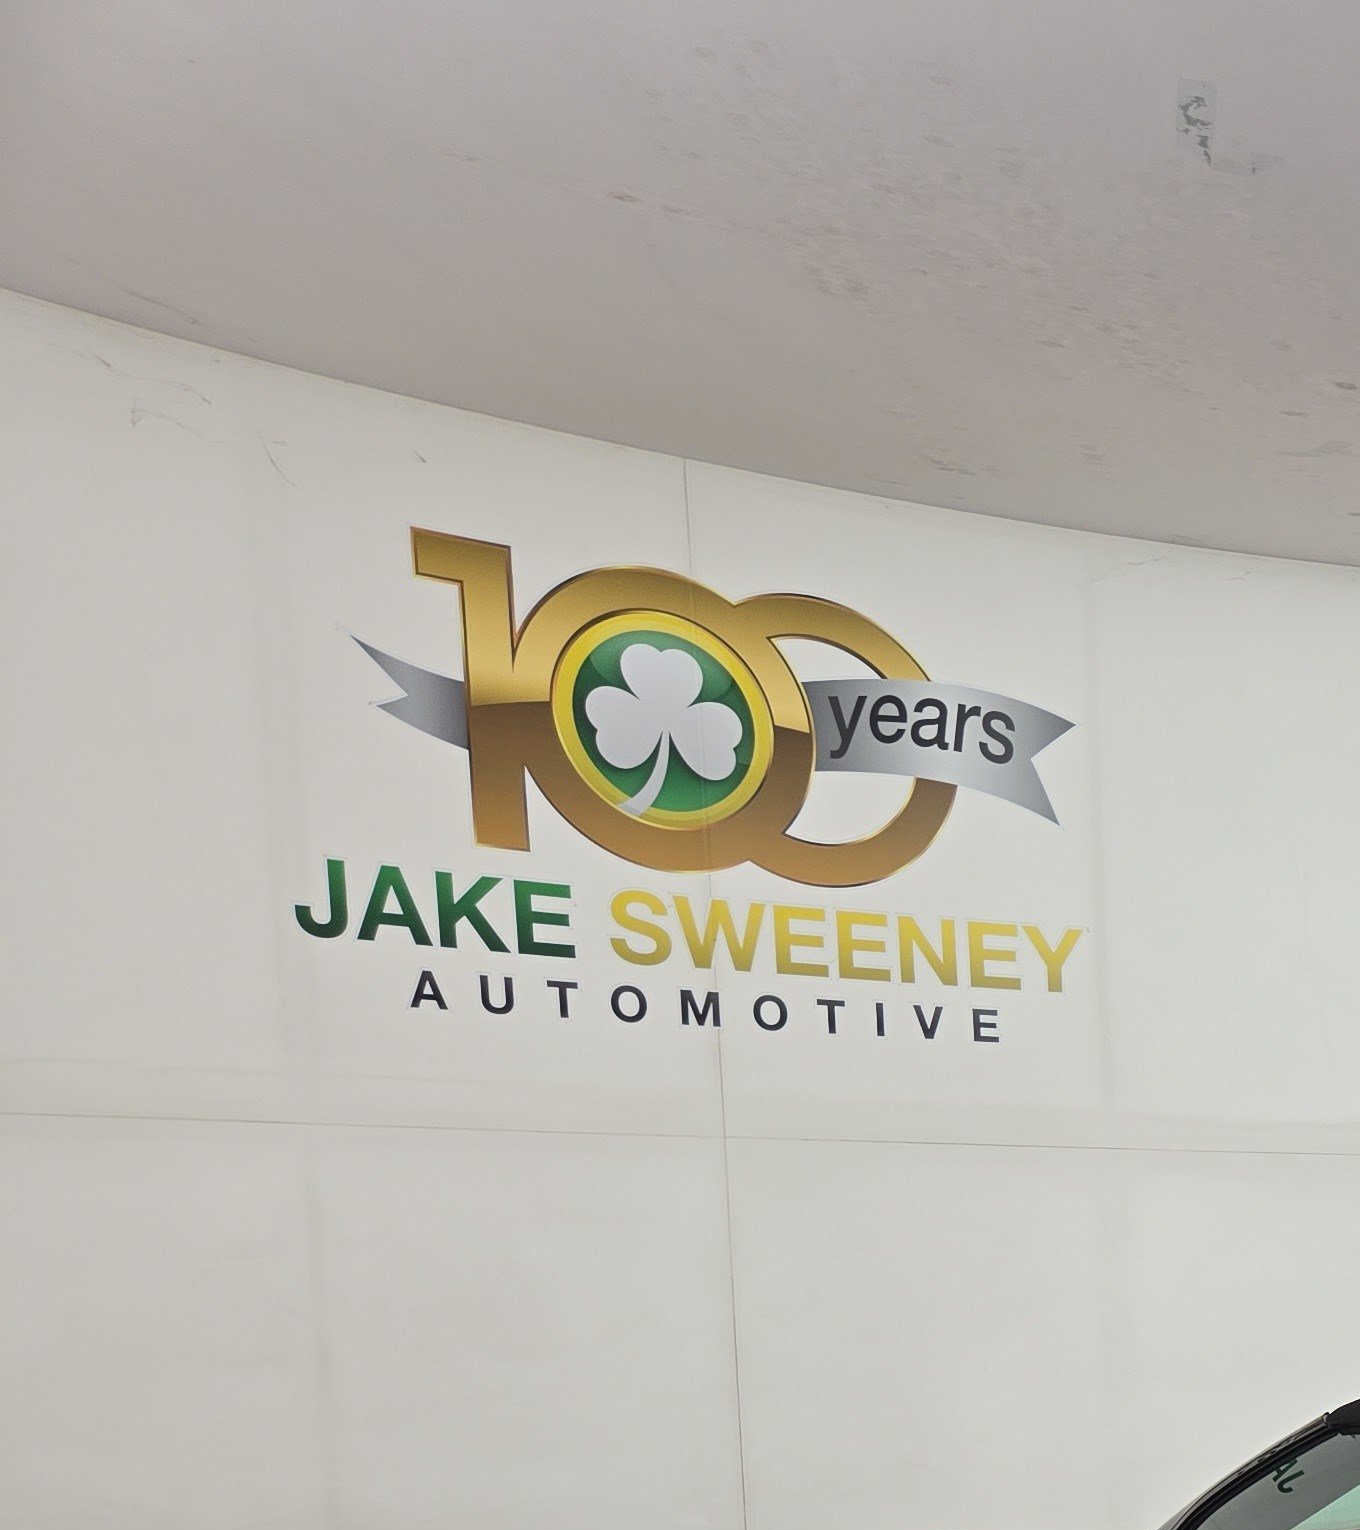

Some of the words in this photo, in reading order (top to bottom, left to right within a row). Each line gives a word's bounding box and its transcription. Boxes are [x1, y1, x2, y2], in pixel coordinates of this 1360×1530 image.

[410, 526, 958, 888] 100
[827, 694, 1017, 765] years
[294, 858, 577, 958] JAKE
[610, 890, 1082, 993] SWEENEY
[409, 971, 1001, 1044] AUTOMOTIVE
